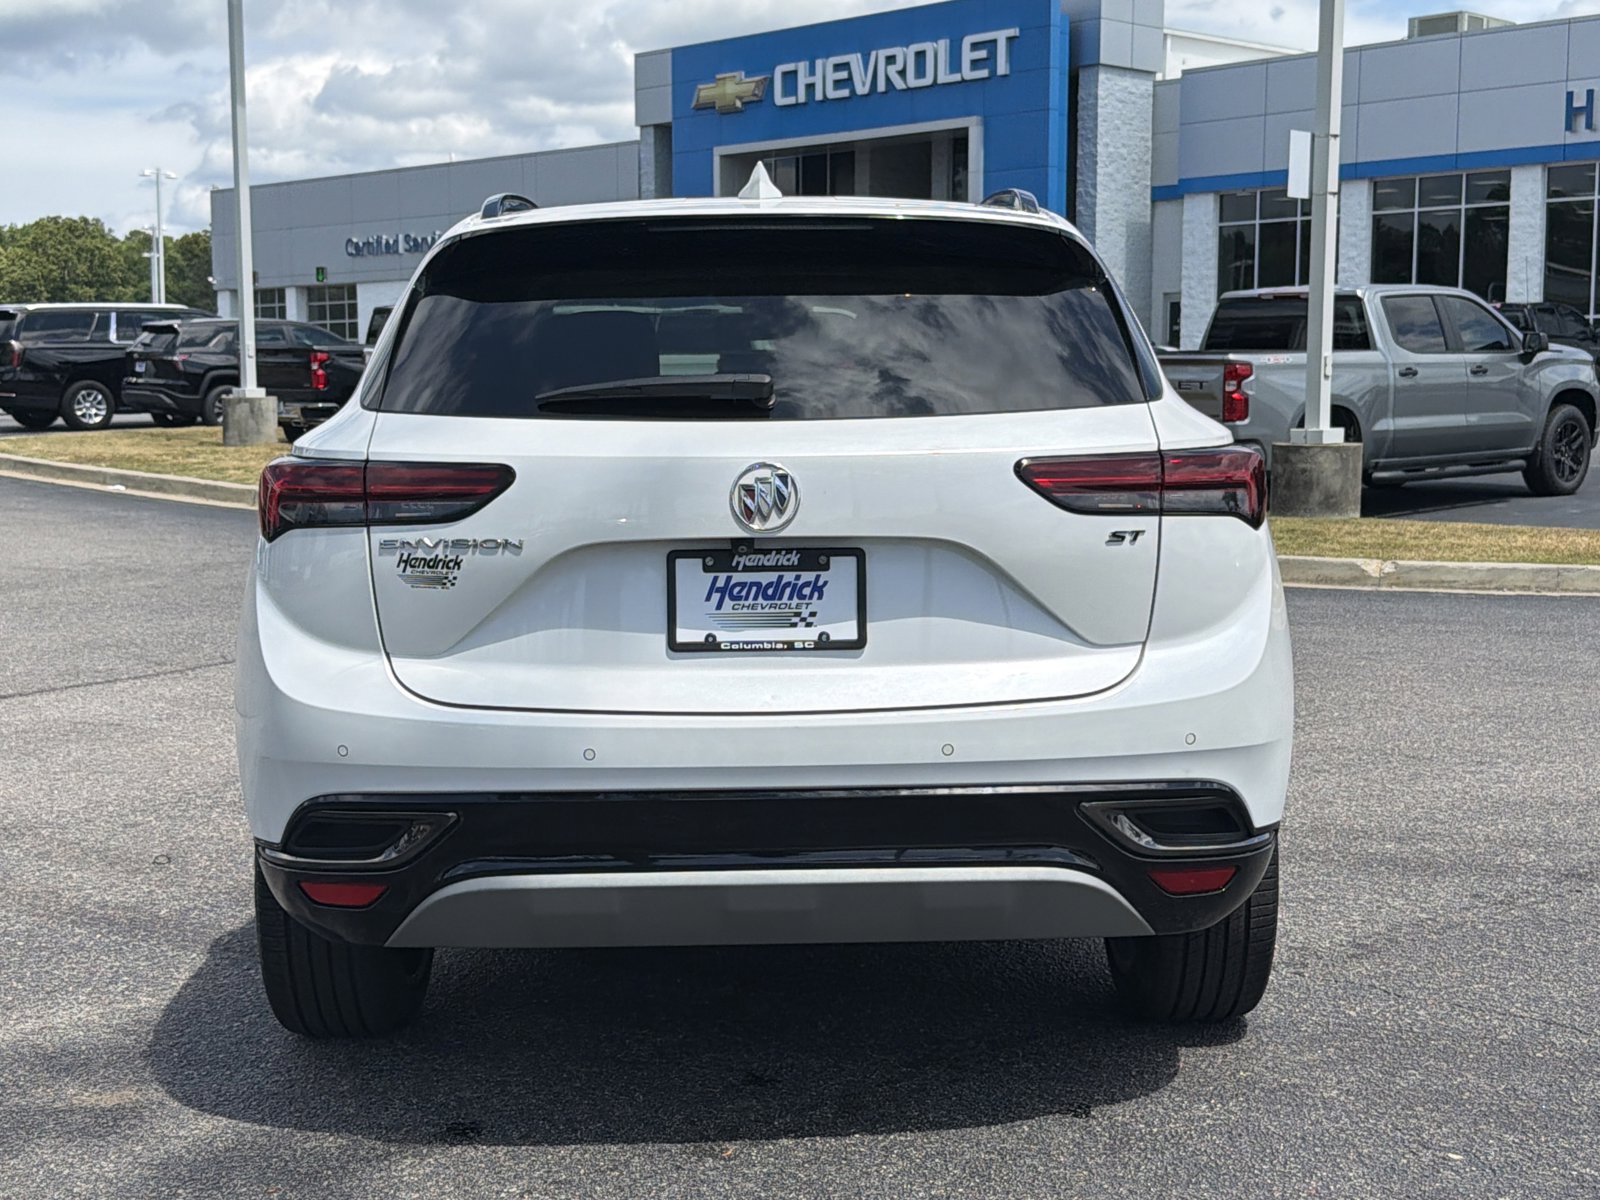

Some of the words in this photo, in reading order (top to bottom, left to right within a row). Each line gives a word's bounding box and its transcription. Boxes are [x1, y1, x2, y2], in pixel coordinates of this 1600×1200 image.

[773, 27, 1020, 107] CHEVROLET
[345, 233, 402, 257] Certified
[1105, 530, 1146, 546] ST
[396, 552, 464, 573] Hendrick
[731, 550, 801, 571] Hendrick
[704, 573, 829, 611] Hendrick
[731, 602, 813, 611] CHEVROLET
[720, 641, 788, 651] Columbia,
[794, 641, 815, 649] SC
